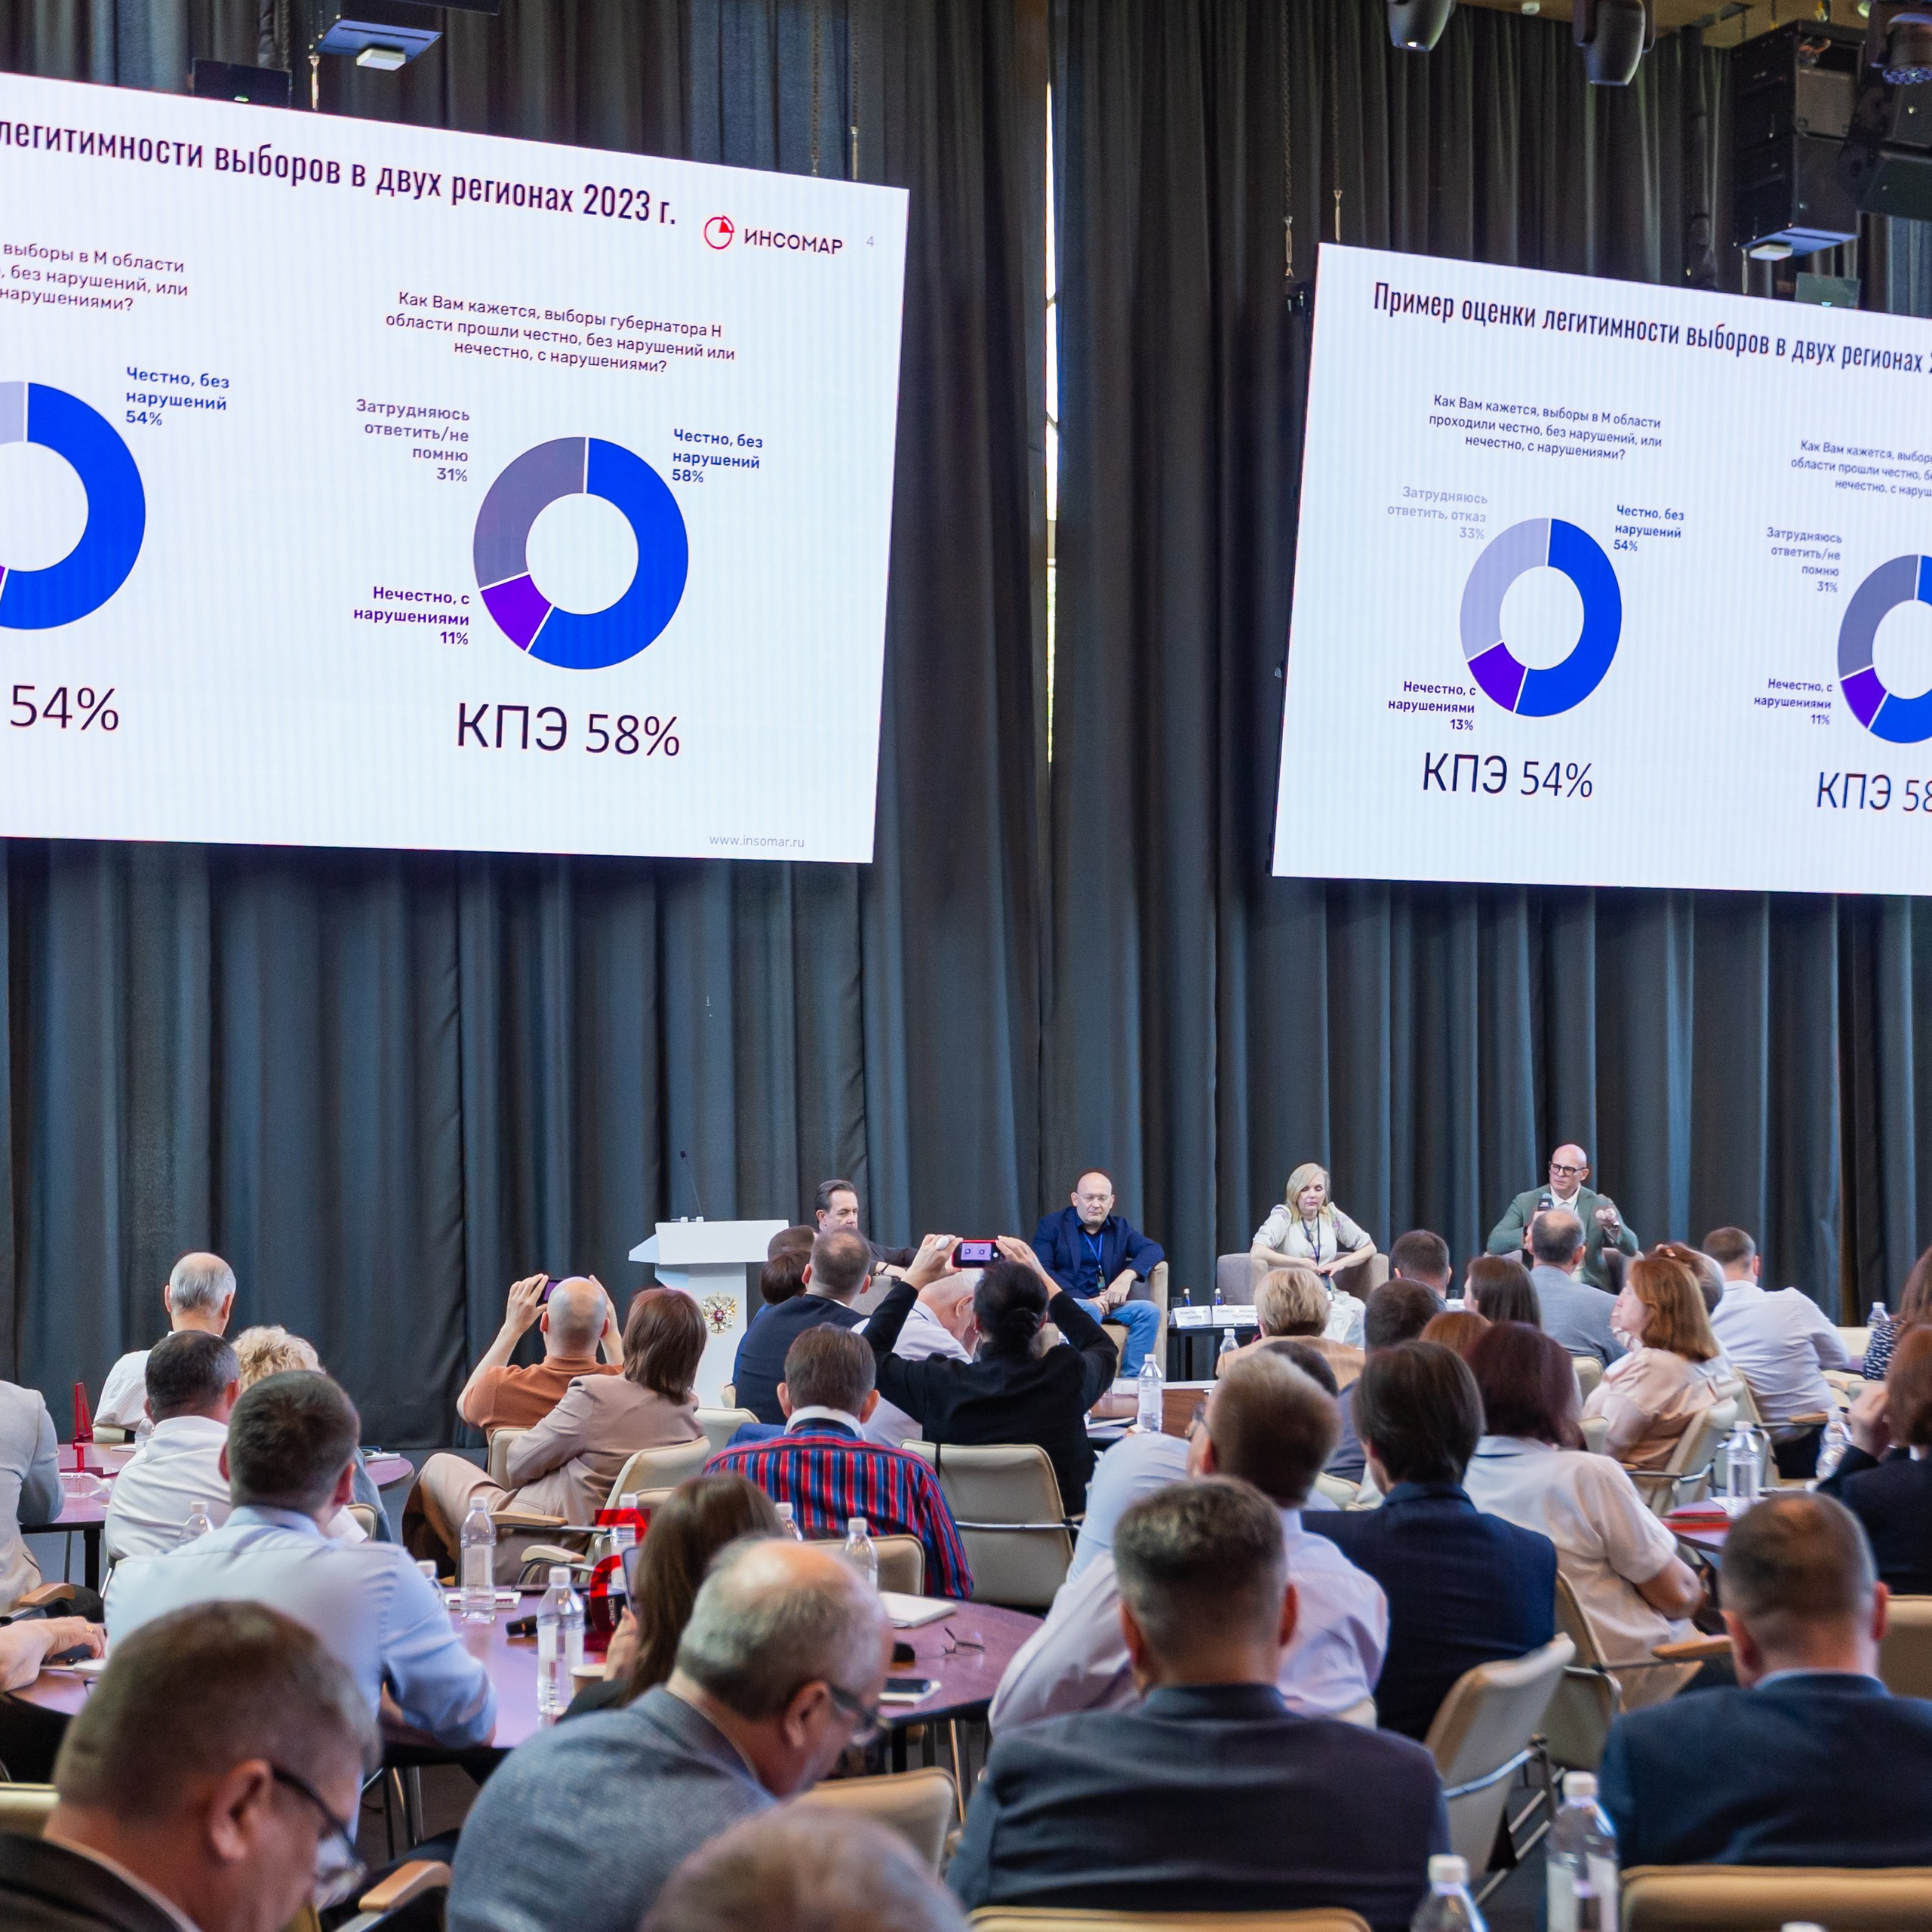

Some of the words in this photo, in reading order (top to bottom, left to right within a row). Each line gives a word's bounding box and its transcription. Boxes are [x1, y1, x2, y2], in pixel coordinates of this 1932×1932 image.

[214, 144, 340, 187] выборов
[351, 163, 366, 188] в
[375, 167, 442, 201] двух
[451, 176, 574, 213] регионах
[583, 183, 651, 222] 2023
[659, 201, 675, 225] г.
[744, 228, 843, 255] ИНСОМАР
[866, 235, 875, 248] 4
[3, 242, 74, 263] выборы
[78, 251, 89, 263] в
[94, 250, 107, 266] М
[112, 253, 184, 273] области
[11, 264, 42, 281] без
[46, 271, 152, 294] нарушений,
[155, 283, 188, 297] или
[398, 291, 428, 308] Как
[432, 294, 464, 311] Вам
[468, 301, 540, 321] кажется,
[544, 308, 606, 328] выборы
[610, 315, 707, 338] губернатора
[711, 324, 721, 338] Н
[386, 312, 454, 332] области
[457, 322, 519, 339] прошли
[522, 329, 582, 346] честно,
[586, 332, 613, 348] без
[617, 339, 704, 357] нарушений
[706, 348, 735, 361] или
[1374, 281, 1455, 324] Пример
[1461, 300, 1537, 328] оценки
[1541, 309, 1680, 345] легитимности
[1686, 323, 1770, 358] выборов
[1775, 337, 1786, 357] в
[1791, 340, 1836, 366] двух
[1841, 345, 1923, 374] регионах
[454, 342, 534, 361] нечестно,
[537, 350, 546, 361] с
[550, 352, 667, 373] нарушениями?
[126, 366, 195, 387] Честно,
[199, 372, 230, 389] без
[126, 392, 227, 411] нарушений
[355, 398, 470, 421] Затрудняюсь
[125, 409, 163, 426] 54%
[1433, 394, 1457, 408] Как
[1459, 396, 1483, 411] Вам
[1485, 402, 1540, 417] кажется,
[1542, 406, 1589, 423] выборы
[1592, 413, 1599, 423] в
[1601, 411, 1611, 424] М
[1613, 413, 1661, 429] области
[364, 423, 469, 442] ответить/не
[673, 428, 734, 448] Честно,
[737, 433, 763, 449] без
[1429, 415, 1497, 431] проходили
[1498, 422, 1543, 436] честно,
[1546, 423, 1567, 438] без
[1568, 429, 1638, 446] нарушений,
[1640, 437, 1663, 448] или
[412, 448, 469, 463] помню
[1465, 436, 1525, 452] нечестно,
[1527, 442, 1534, 452] с
[1537, 443, 1626, 460] нарушениями?
[1800, 439, 1821, 453] Как
[1823, 441, 1844, 455] Вам
[1846, 447, 1895, 460] кажется,
[672, 452, 760, 469] нарушений
[1790, 456, 1836, 472] области
[1838, 463, 1880, 476] прошли
[1881, 468, 1921, 481] честно,
[436, 466, 468, 482] 31%
[671, 468, 704, 484] 58%
[1402, 485, 1488, 504] Затрудняюсь
[1835, 480, 1888, 494] нечестно,
[1387, 506, 1448, 521] ответить,
[1451, 511, 1486, 523] отказ
[1616, 503, 1662, 520] Честно,
[1664, 508, 1684, 521] без
[1459, 526, 1485, 540] 33%
[1614, 525, 1681, 539] нарушений
[1766, 526, 1843, 544] Затрудняюсь
[1613, 539, 1638, 552] 54%
[1770, 546, 1841, 561] ответить/не
[1801, 565, 1840, 577] помню
[373, 586, 457, 605] Нечестно,
[460, 595, 470, 605] с
[1816, 580, 1838, 593] 31%
[353, 608, 469, 626] нарушениями
[439, 631, 469, 646] 11%
[1403, 680, 1466, 697] Нечестно,
[1469, 687, 1477, 697] с
[1767, 678, 1825, 693] Нечестно,
[10, 685, 119, 731] 54%
[1388, 700, 1475, 714] нарушениями
[1753, 697, 1832, 709] нарушениями
[1449, 718, 1474, 731] 13%
[1810, 713, 1830, 725] 11%
[457, 702, 568, 752] КПЭ
[586, 713, 680, 757] 58%
[1423, 752, 1508, 795] КПЭ
[1520, 760, 1593, 798] 54%
[1817, 771, 1892, 811] КПЭ
[709, 835, 804, 848] www.insomar.ru
